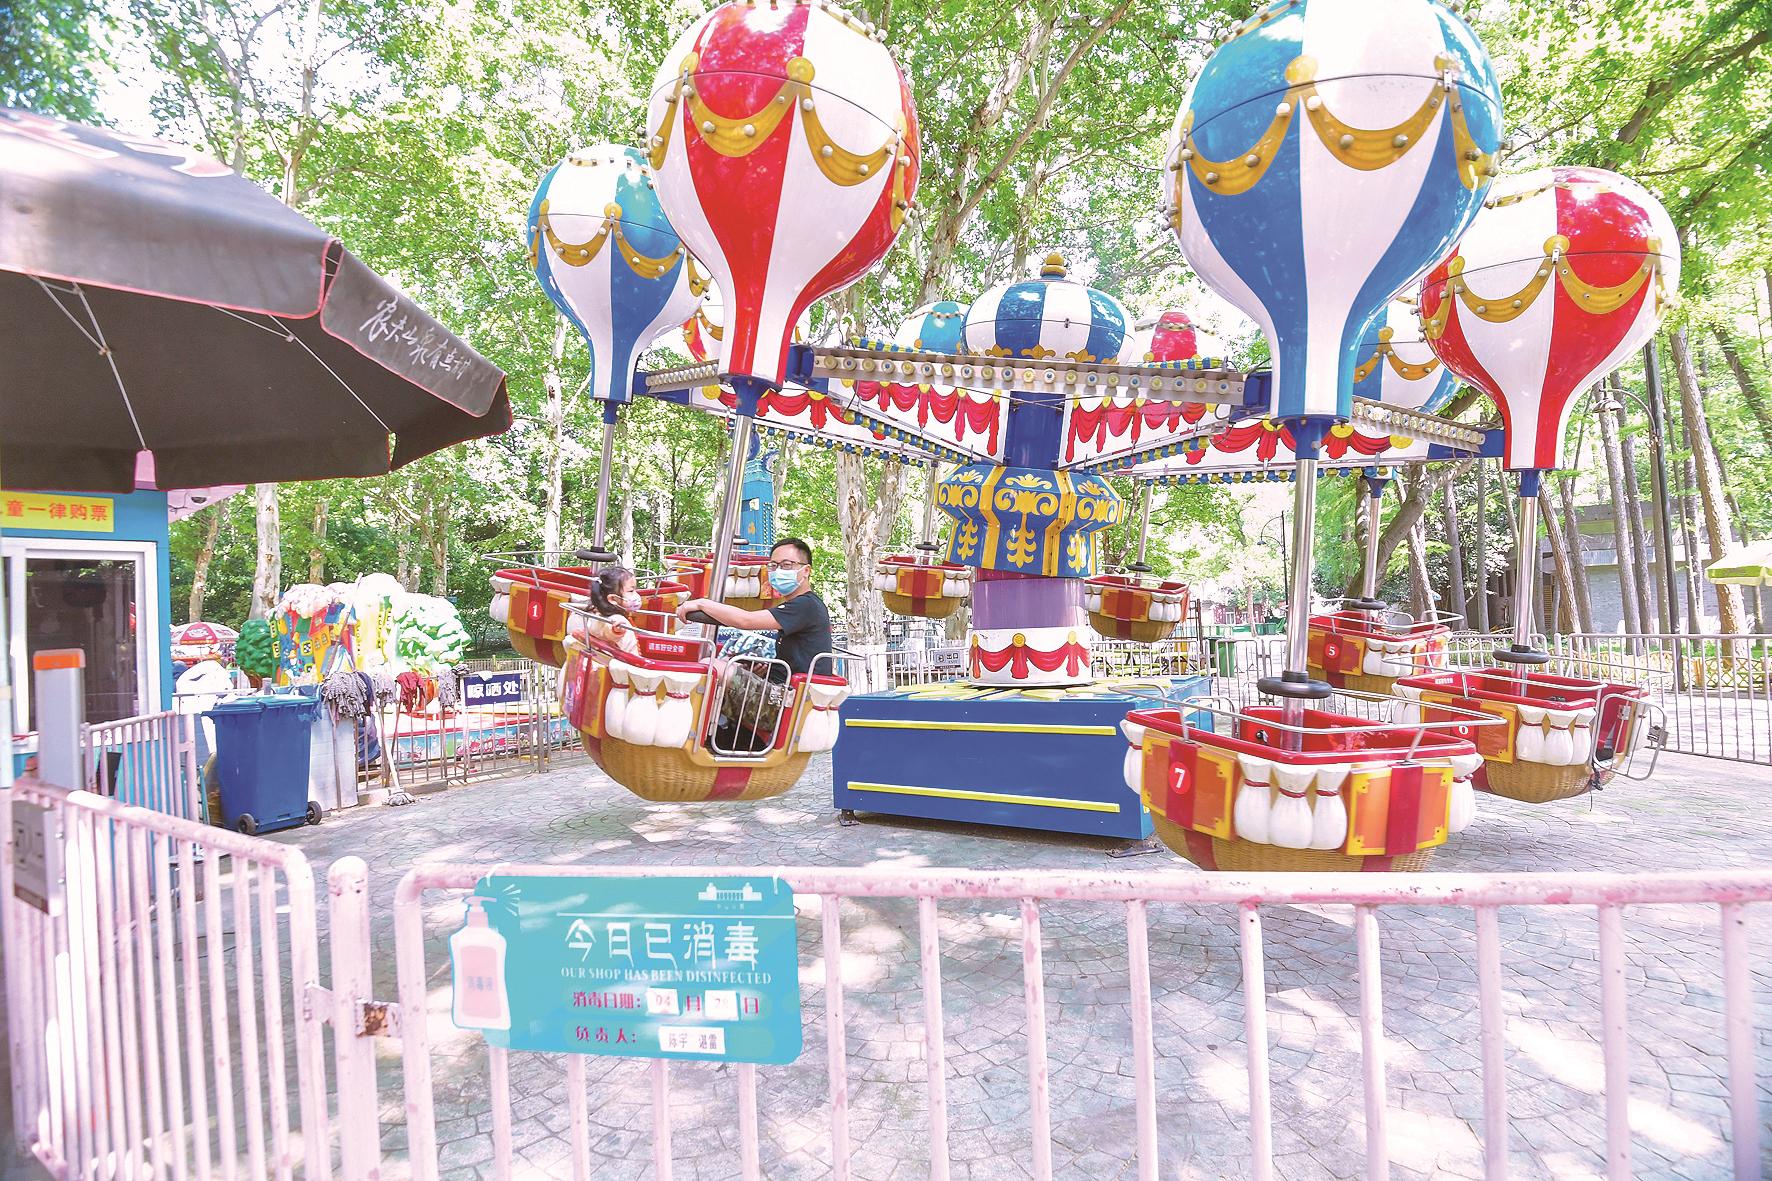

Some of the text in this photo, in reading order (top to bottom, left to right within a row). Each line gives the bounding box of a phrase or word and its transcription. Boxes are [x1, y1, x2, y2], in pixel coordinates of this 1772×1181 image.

[359, 295, 472, 380] 农夫山泉有点甜
[0, 500, 108, 521] 童一律购票
[532, 604, 538, 618] 1
[1329, 645, 1336, 656] 5
[467, 680, 519, 699] 晾晒处
[575, 676, 582, 695] 8
[1174, 767, 1186, 789] 7
[564, 918, 760, 971] 今日已消毒
[560, 967, 772, 985] OUR SHOP HAS BEEN DISINFECTED
[744, 997, 760, 1015] 日
